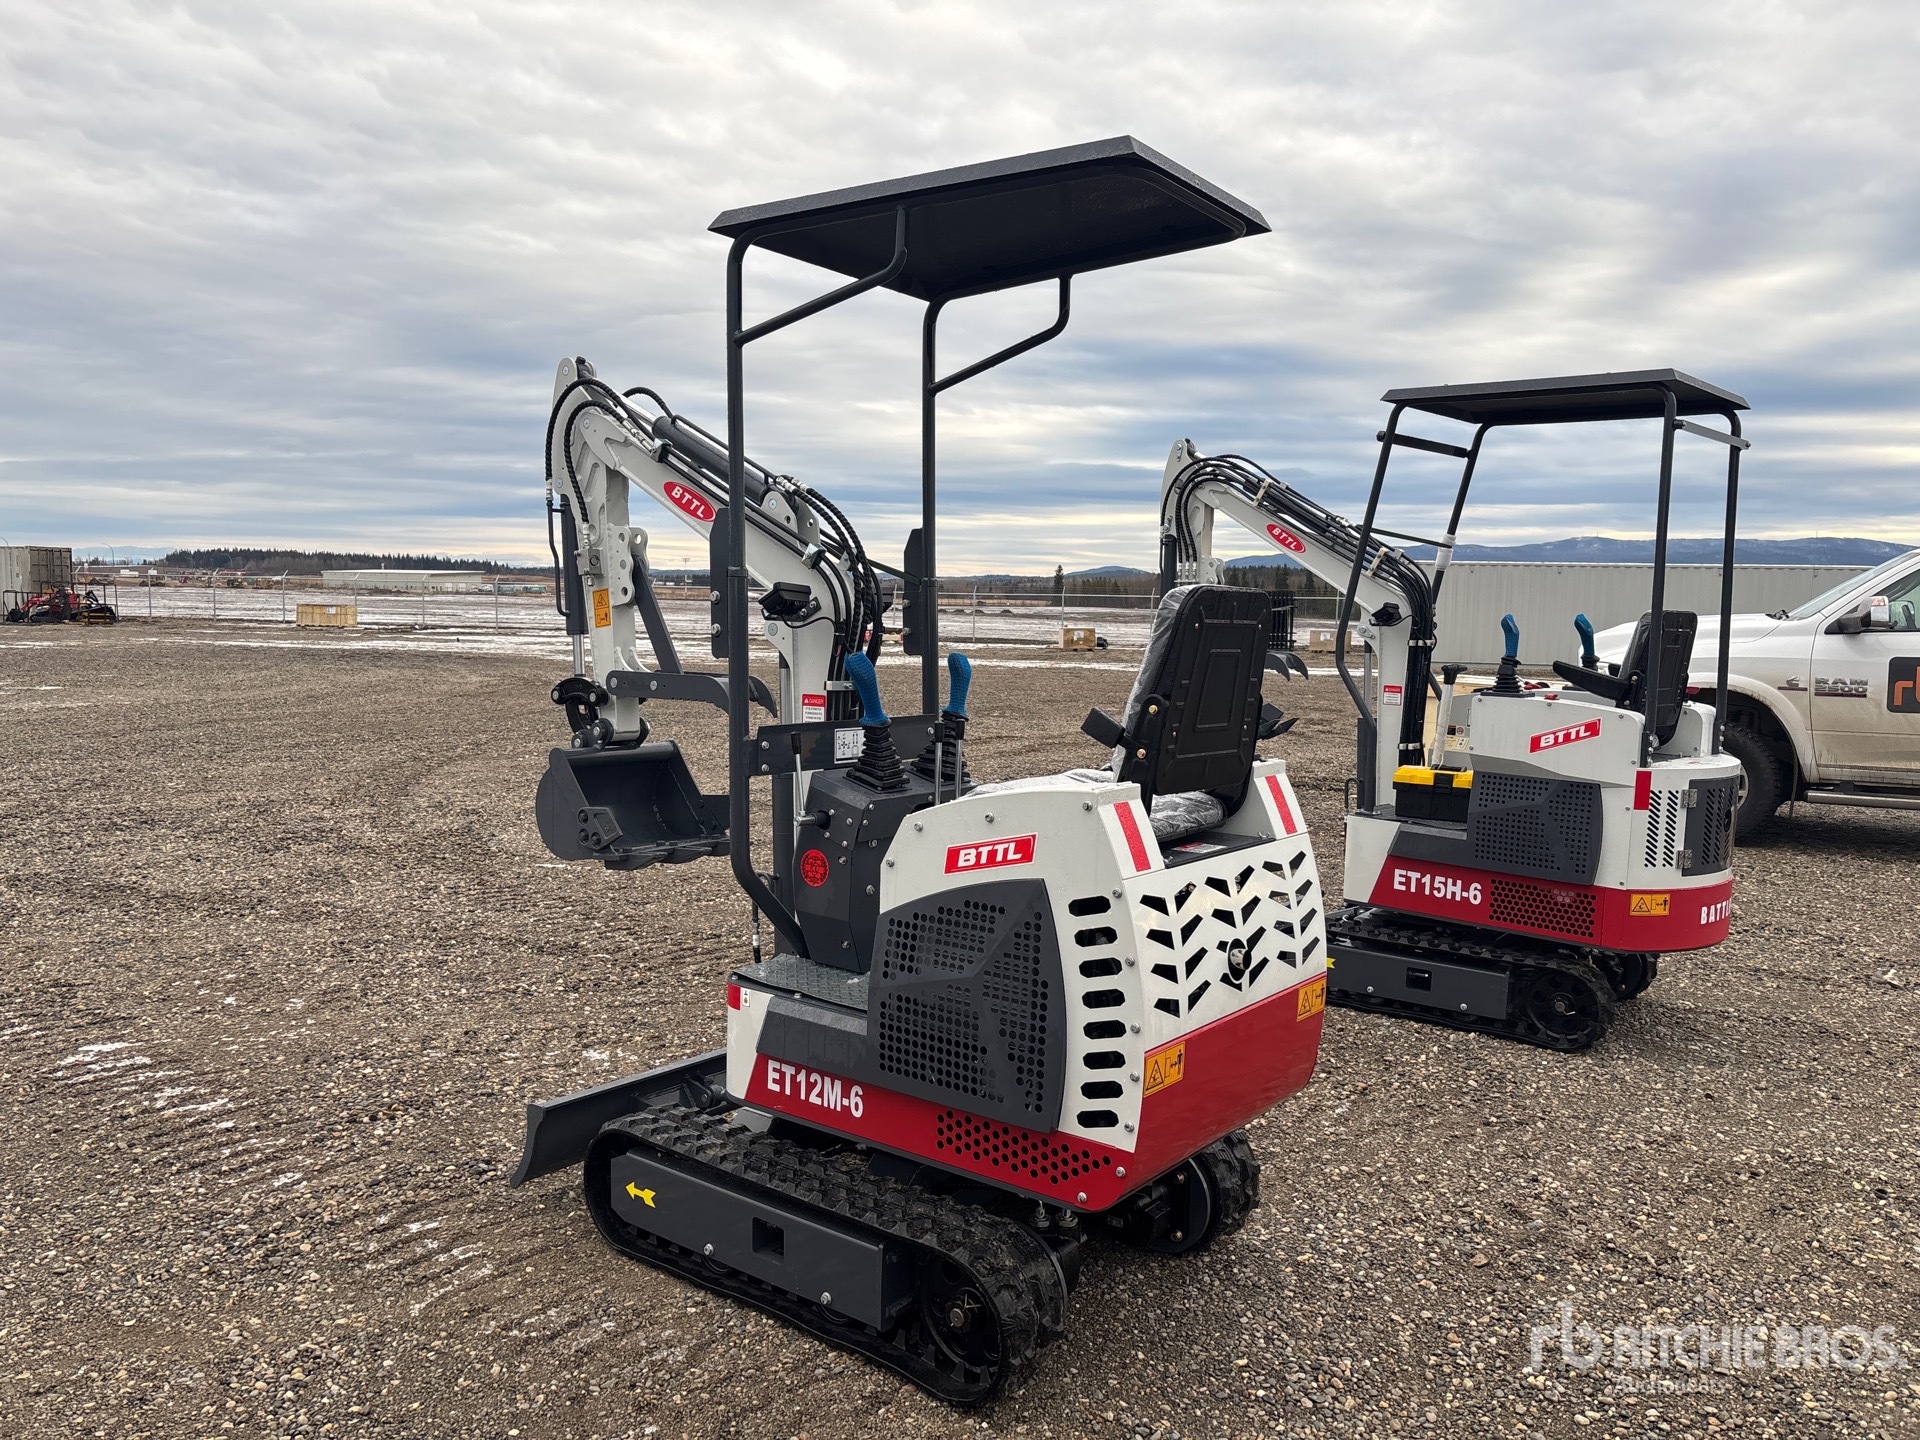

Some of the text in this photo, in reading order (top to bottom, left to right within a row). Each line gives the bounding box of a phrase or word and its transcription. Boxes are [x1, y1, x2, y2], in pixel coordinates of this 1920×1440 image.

[671, 485, 705, 518] BTTL
[1272, 527, 1298, 550] BTTL
[1815, 677, 1868, 685] RAM
[1815, 684, 1868, 692] 2500
[1893, 666, 1920, 706] r
[1540, 725, 1591, 748] BTTL
[957, 841, 1023, 868] BTTL
[1393, 868, 1482, 905] ET15H-6
[767, 1058, 864, 1119] ET12M-6
